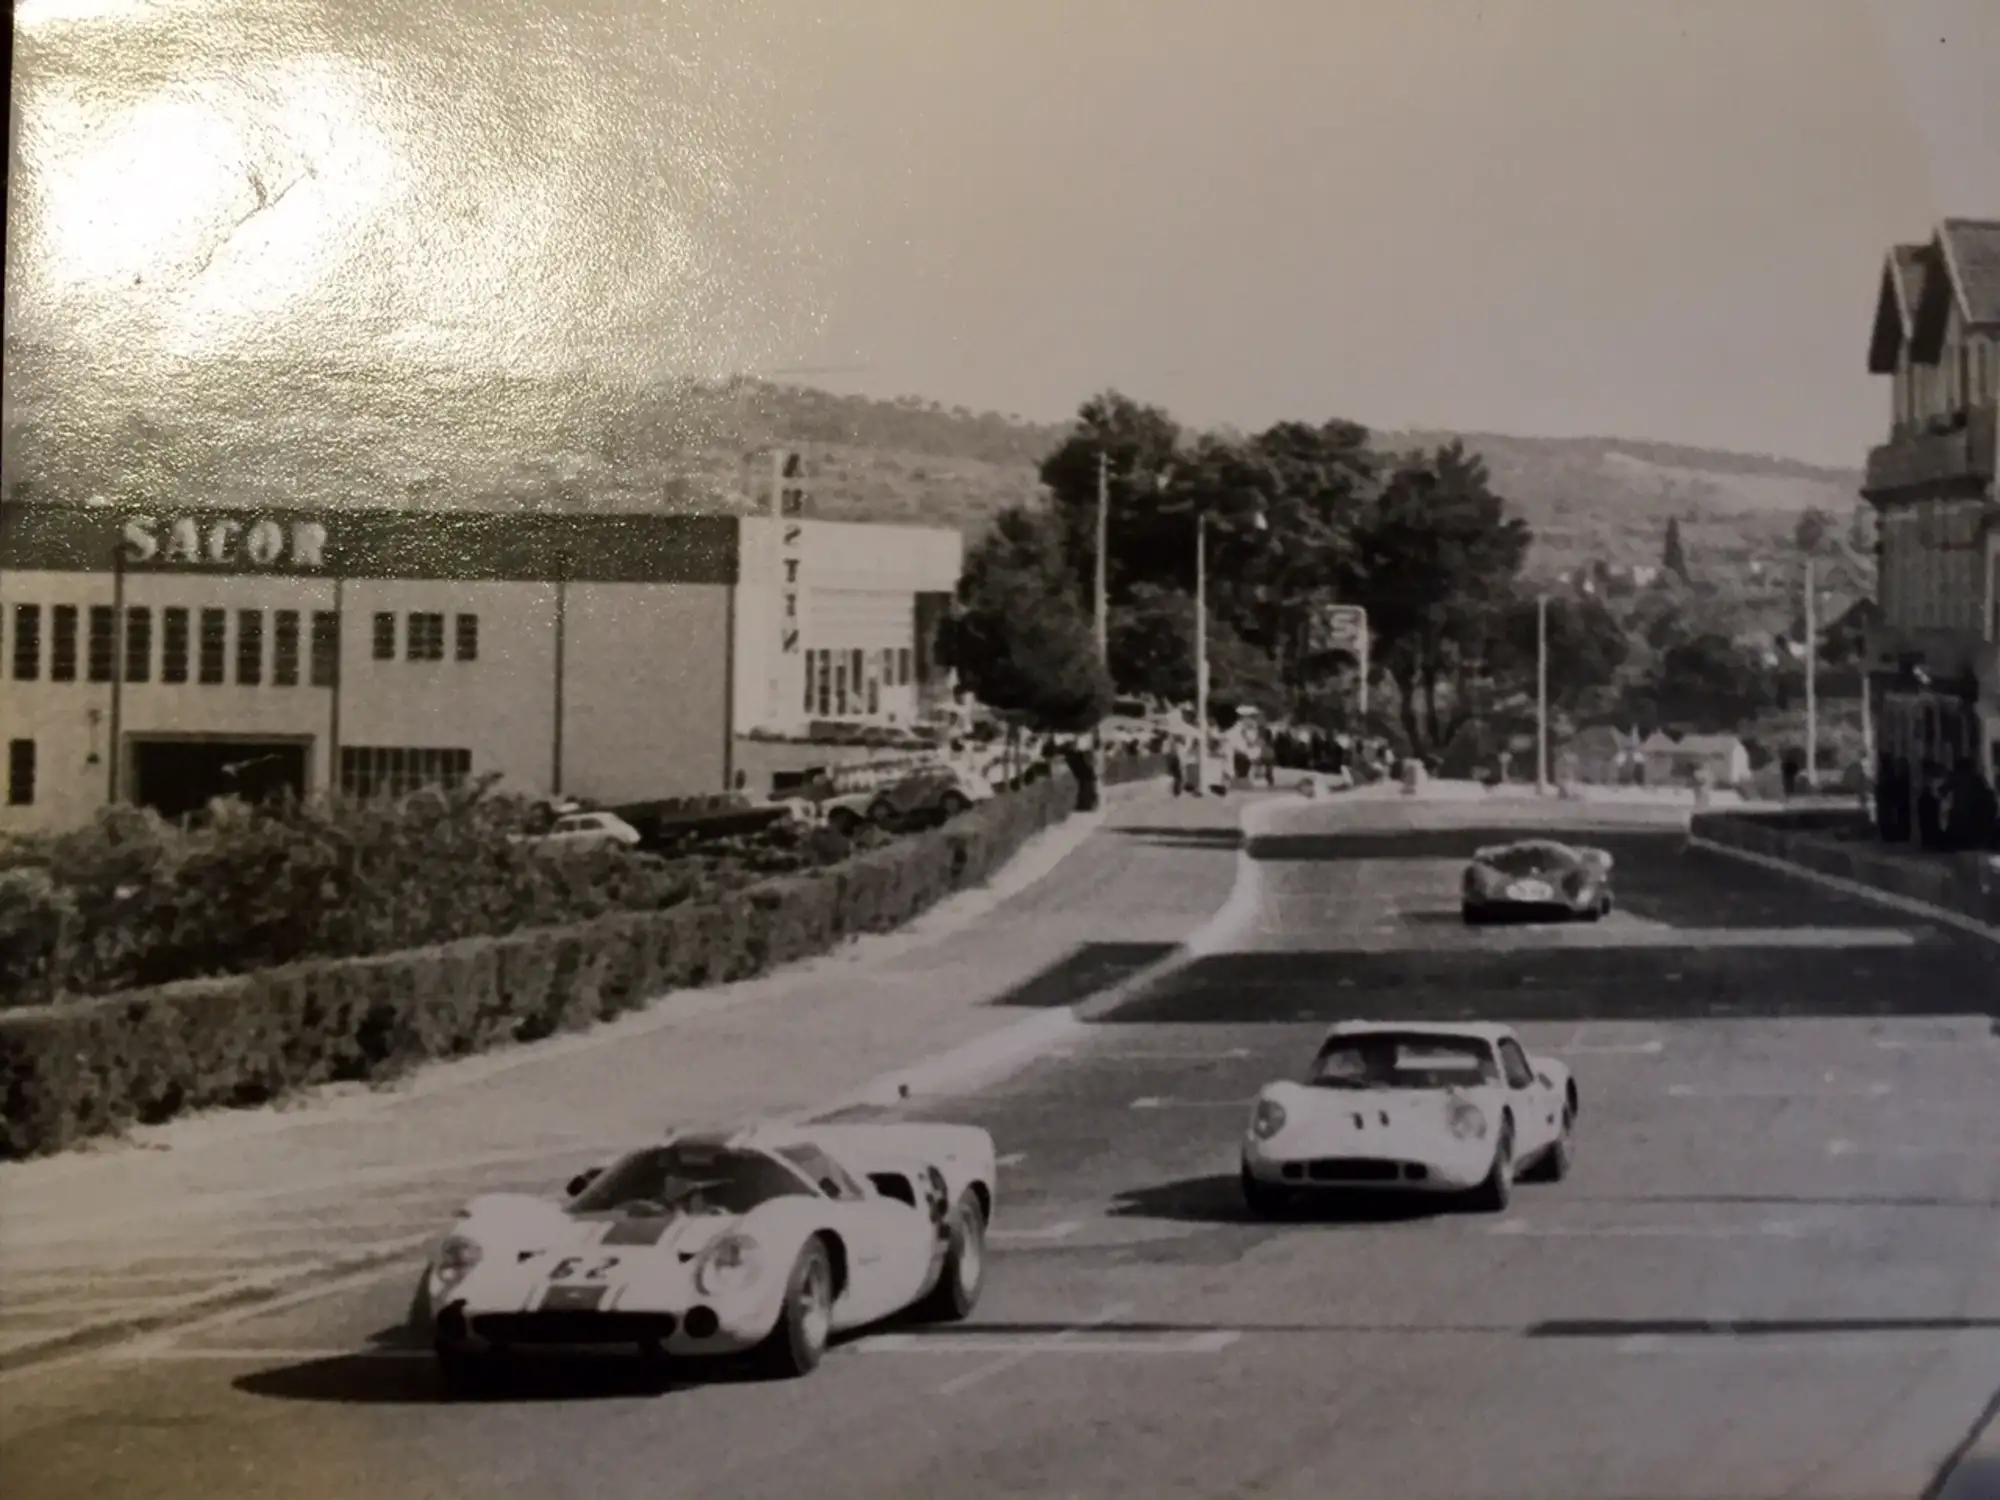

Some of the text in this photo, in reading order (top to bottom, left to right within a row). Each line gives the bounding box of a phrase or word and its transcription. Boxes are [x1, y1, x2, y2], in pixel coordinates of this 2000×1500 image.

[123, 516, 327, 566] SACOR
[1352, 1109, 1389, 1130] 11
[549, 1256, 620, 1280] 62
